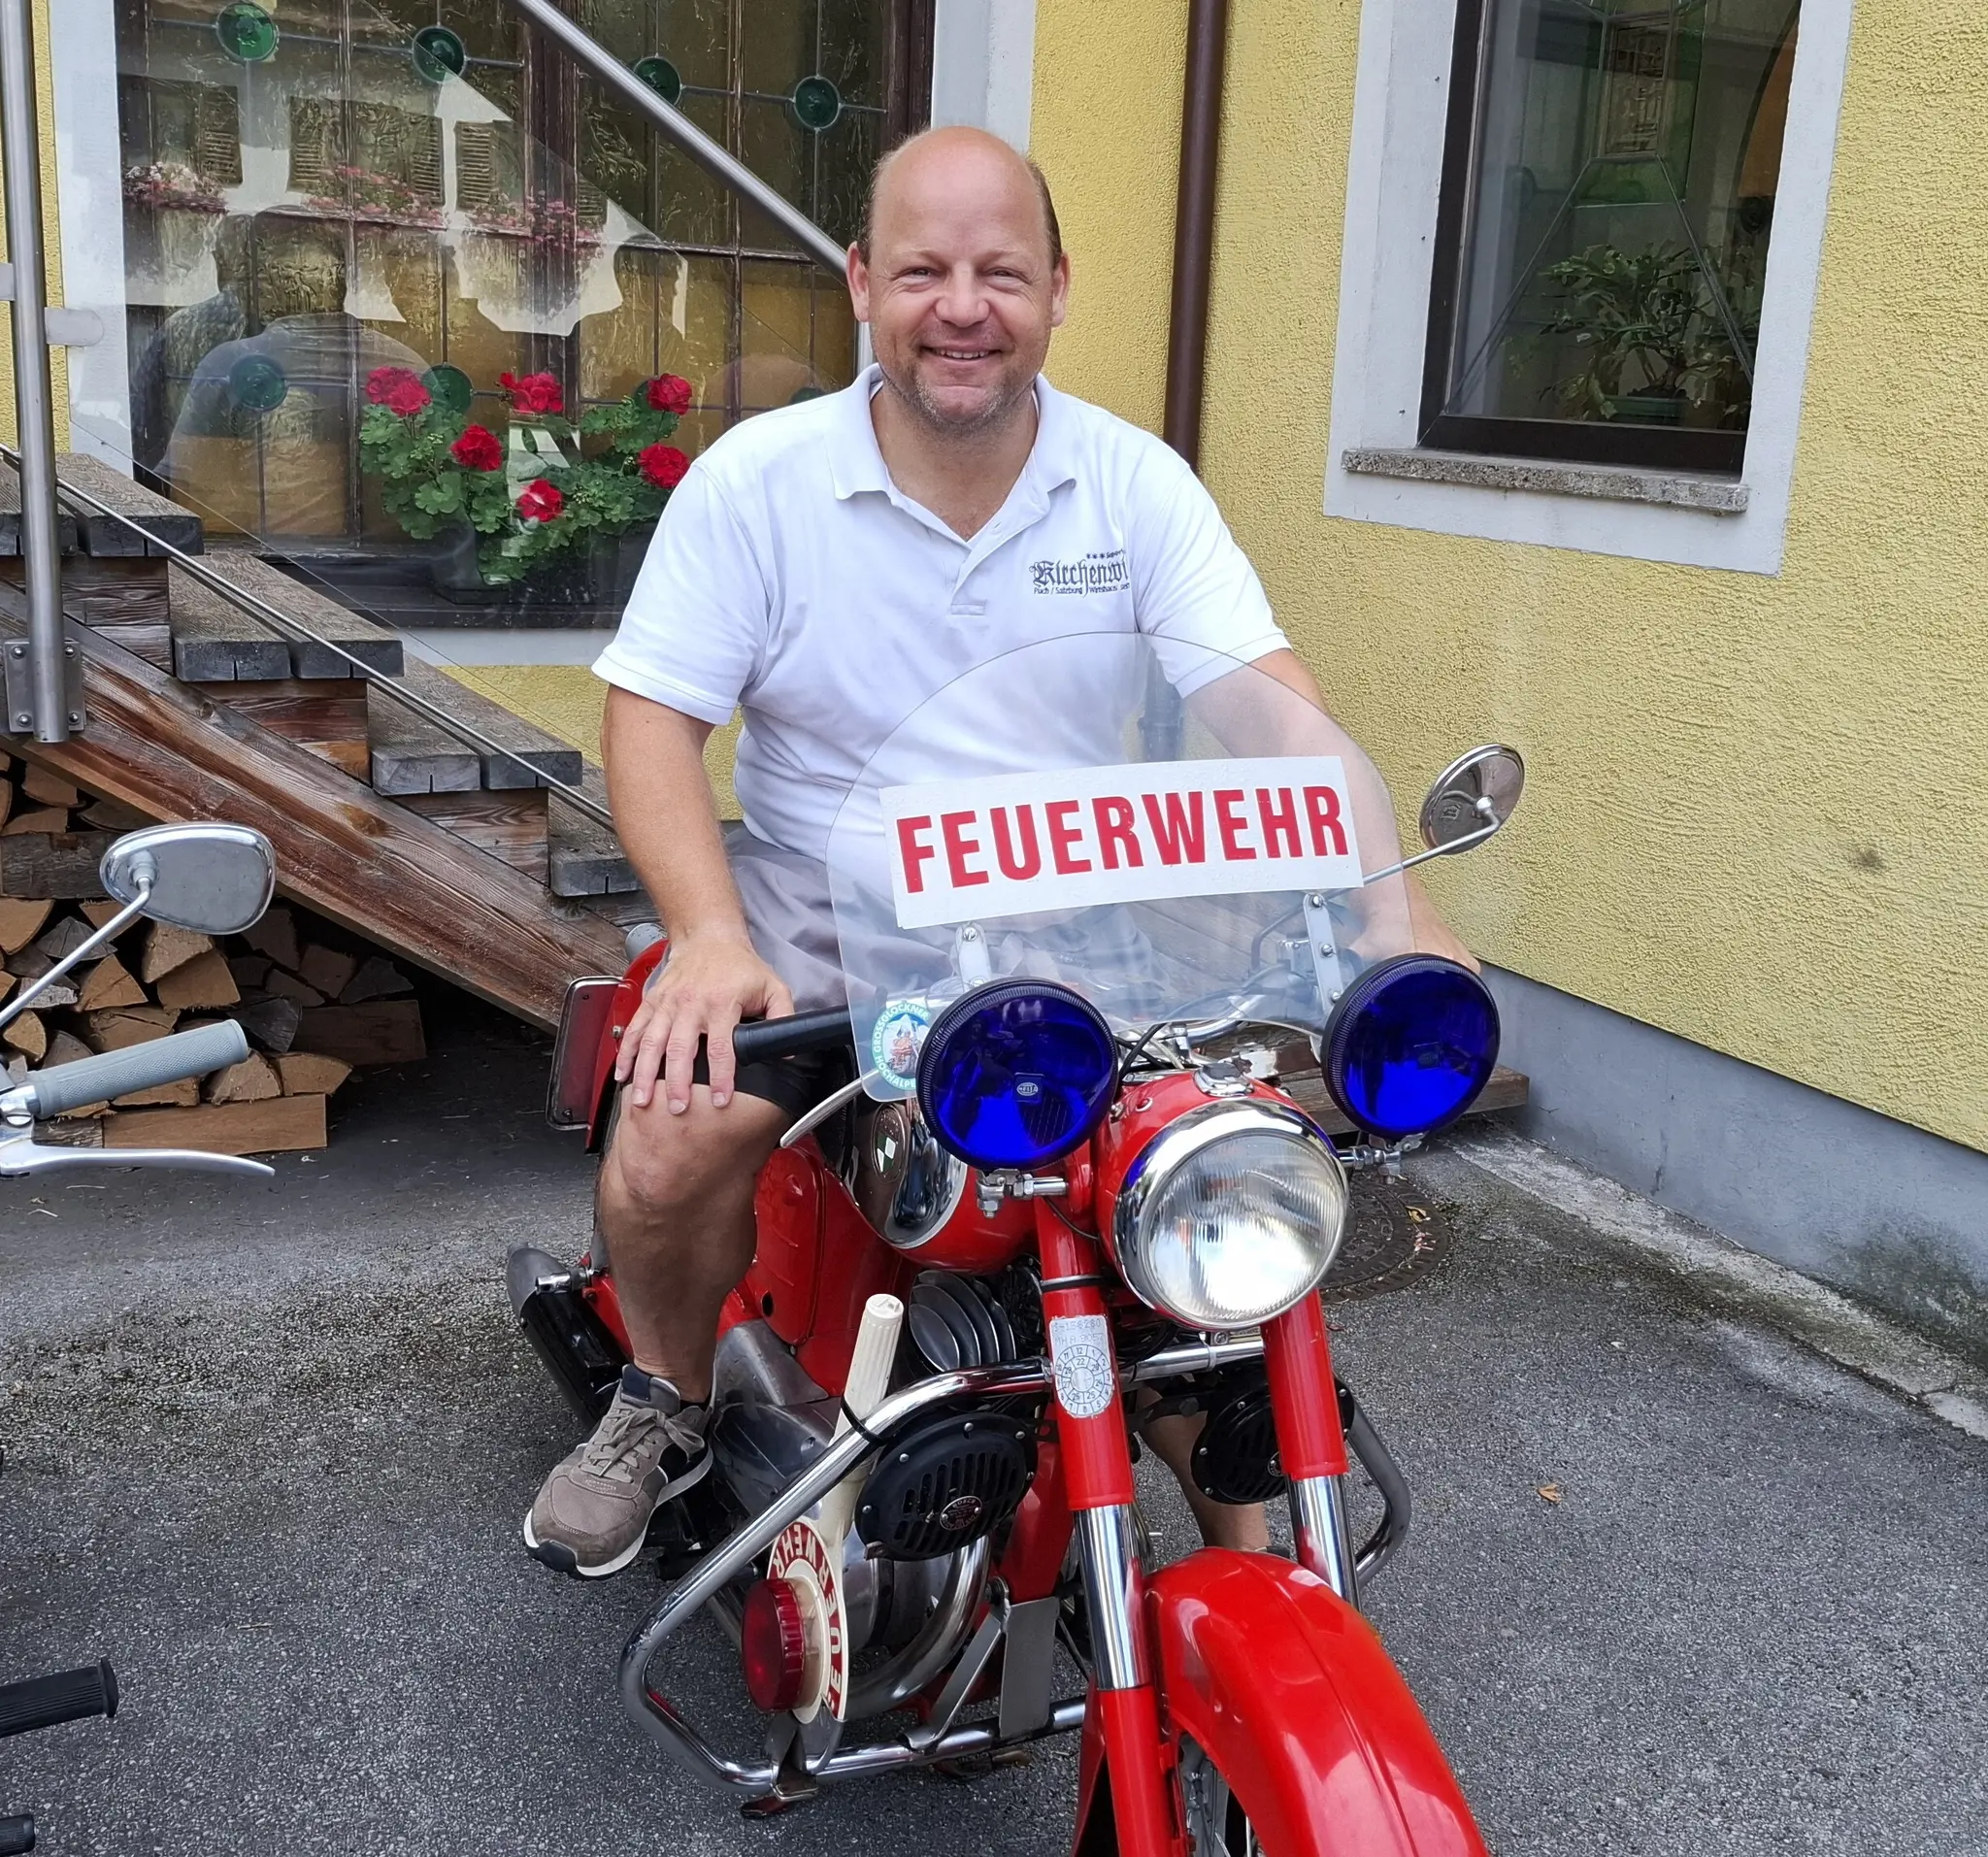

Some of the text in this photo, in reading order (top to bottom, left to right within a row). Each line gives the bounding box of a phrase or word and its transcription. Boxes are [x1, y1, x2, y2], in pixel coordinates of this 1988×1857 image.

[1033, 586, 1049, 595] Puch
[1055, 586, 1083, 595] Salzburg
[896, 785, 1349, 894] FEUERWEHR
[874, 1003, 929, 1053] GROSSGLOCKNER
[1101, 1358, 1107, 1367] 2
[773, 1524, 843, 1711] EUERWEHR
